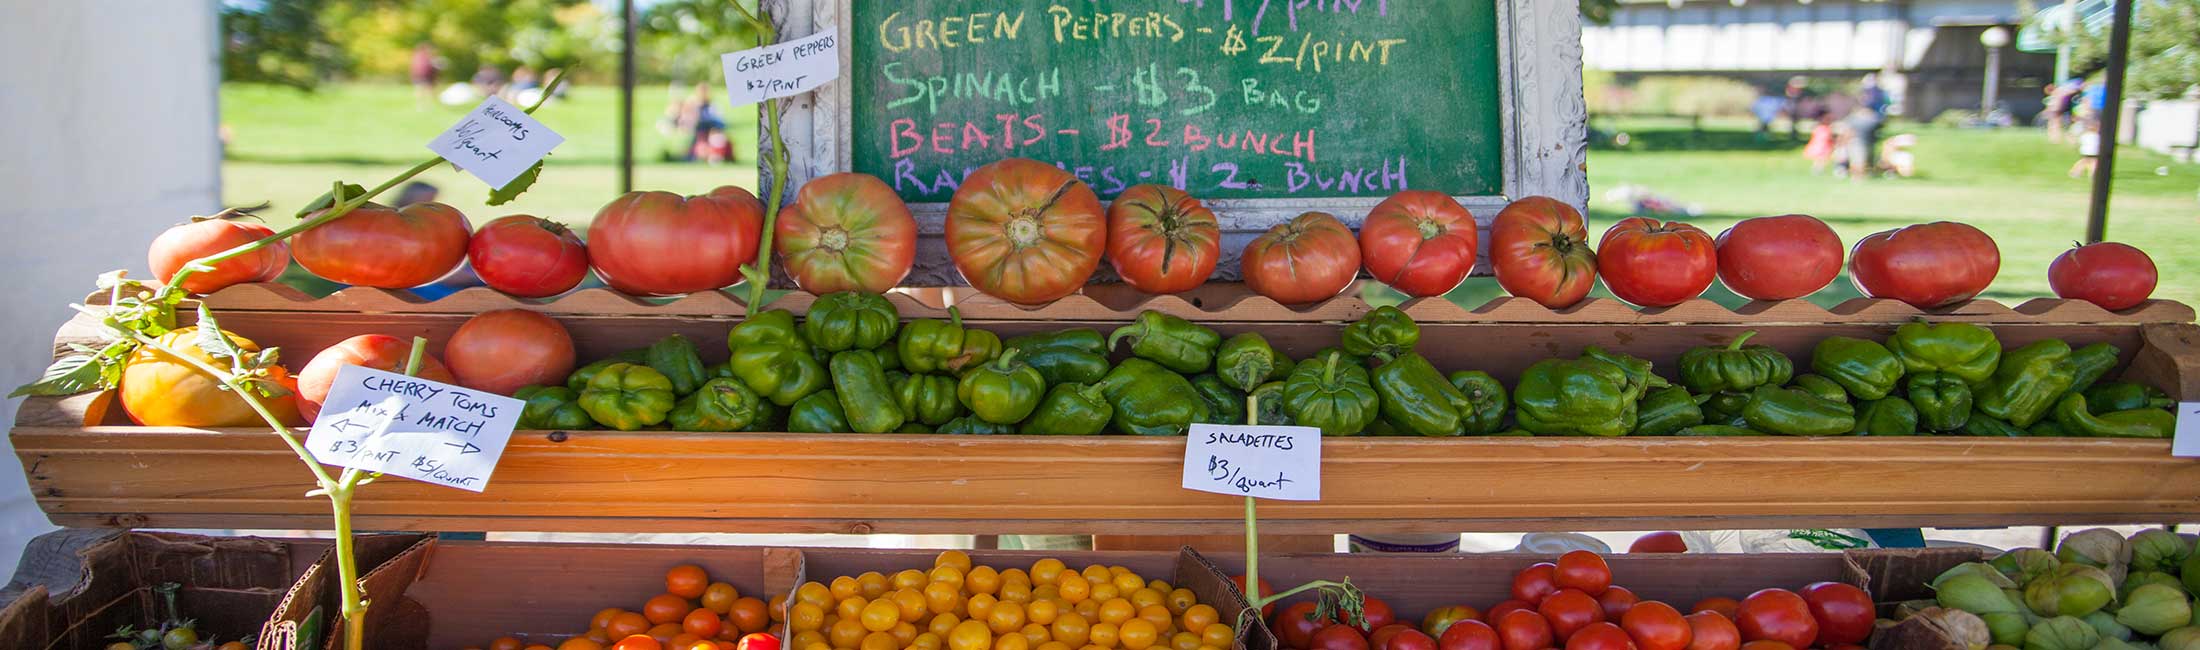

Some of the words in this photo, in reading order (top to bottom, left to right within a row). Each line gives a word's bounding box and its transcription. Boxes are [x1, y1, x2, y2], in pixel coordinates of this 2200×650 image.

[879, 11, 1025, 53] GREEN
[1048, 5, 1185, 44] PEPPERS
[736, 48, 784, 72] GREEN
[793, 35, 835, 59] PEPPERS
[883, 62, 1060, 115] SPINACH
[1241, 78, 1321, 114] BAG
[889, 113, 1046, 159] BEATS
[1183, 124, 1317, 162] BUNCH
[895, 157, 1126, 195] RAES
[1284, 154, 1408, 193] BUNCH
[362, 376, 444, 402] CHERRY
[450, 391, 499, 419] TOMS
[417, 412, 486, 437] MATCH
[1205, 432, 1294, 450] SALADETTES
[329, 440, 401, 463] $3/PNT
